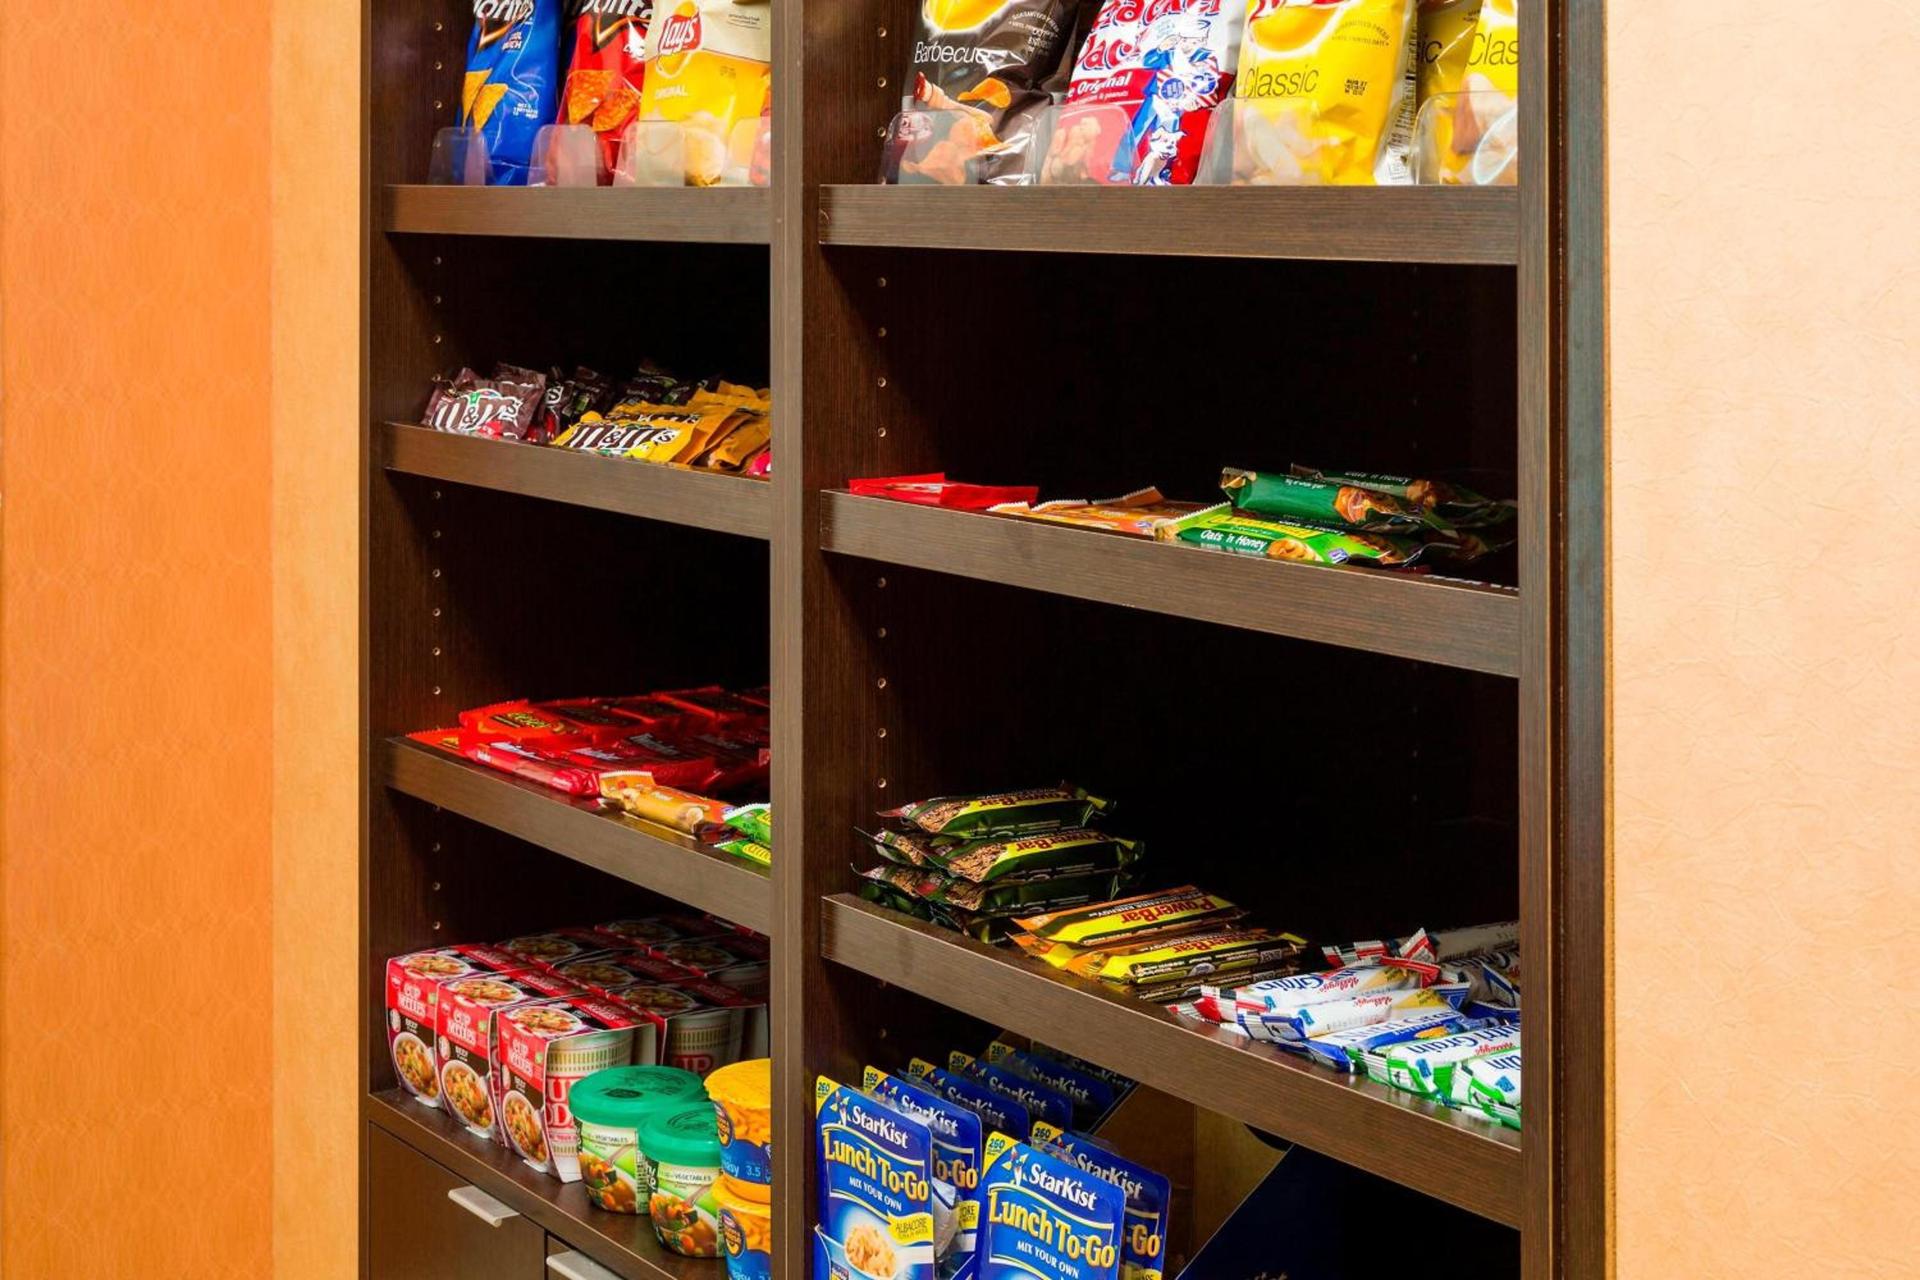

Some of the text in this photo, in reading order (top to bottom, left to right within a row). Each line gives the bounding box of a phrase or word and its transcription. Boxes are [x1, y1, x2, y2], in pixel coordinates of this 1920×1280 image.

[914, 41, 991, 64] Barbecue
[1468, 32, 1520, 65] Clas
[1244, 63, 1318, 98] Classic
[1200, 529, 1223, 542] Oats
[1234, 535, 1268, 553] Honey
[1120, 897, 1218, 925] PowerBar
[852, 1105, 909, 1149] StarKist
[745, 1164, 761, 1177] 3.5
[823, 1131, 930, 1202] Lunch To-Go
[1077, 1152, 1143, 1200] StarKist
[849, 1175, 903, 1212] MIX YOUR OWN
[1029, 1162, 1098, 1211] StarKist
[988, 1190, 1116, 1269] Lunch To-Go
[1016, 1240, 1080, 1280] MIX YOUR OWN
